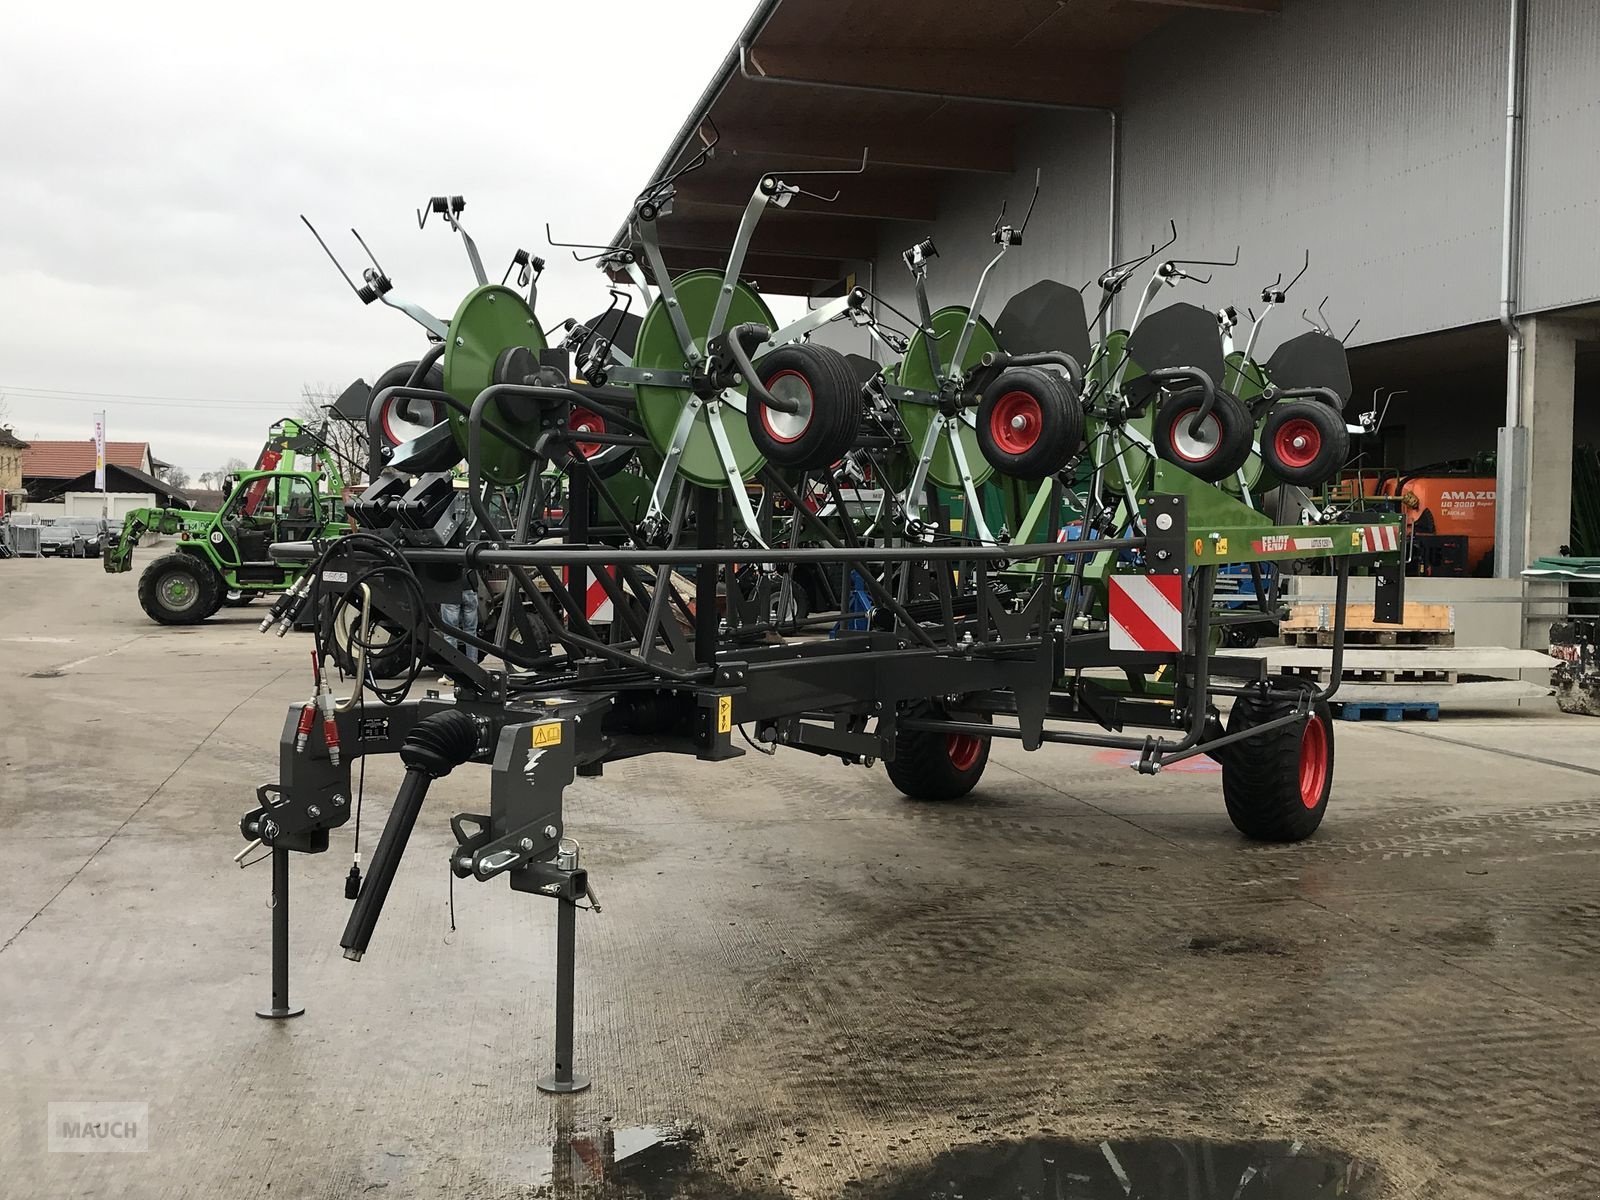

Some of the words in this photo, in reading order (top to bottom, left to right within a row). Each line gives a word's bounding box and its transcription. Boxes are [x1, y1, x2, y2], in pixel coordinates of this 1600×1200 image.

[1441, 491, 1496, 500] AMAZO
[213, 533, 222, 541] 40
[1262, 535, 1290, 552] FENDT
